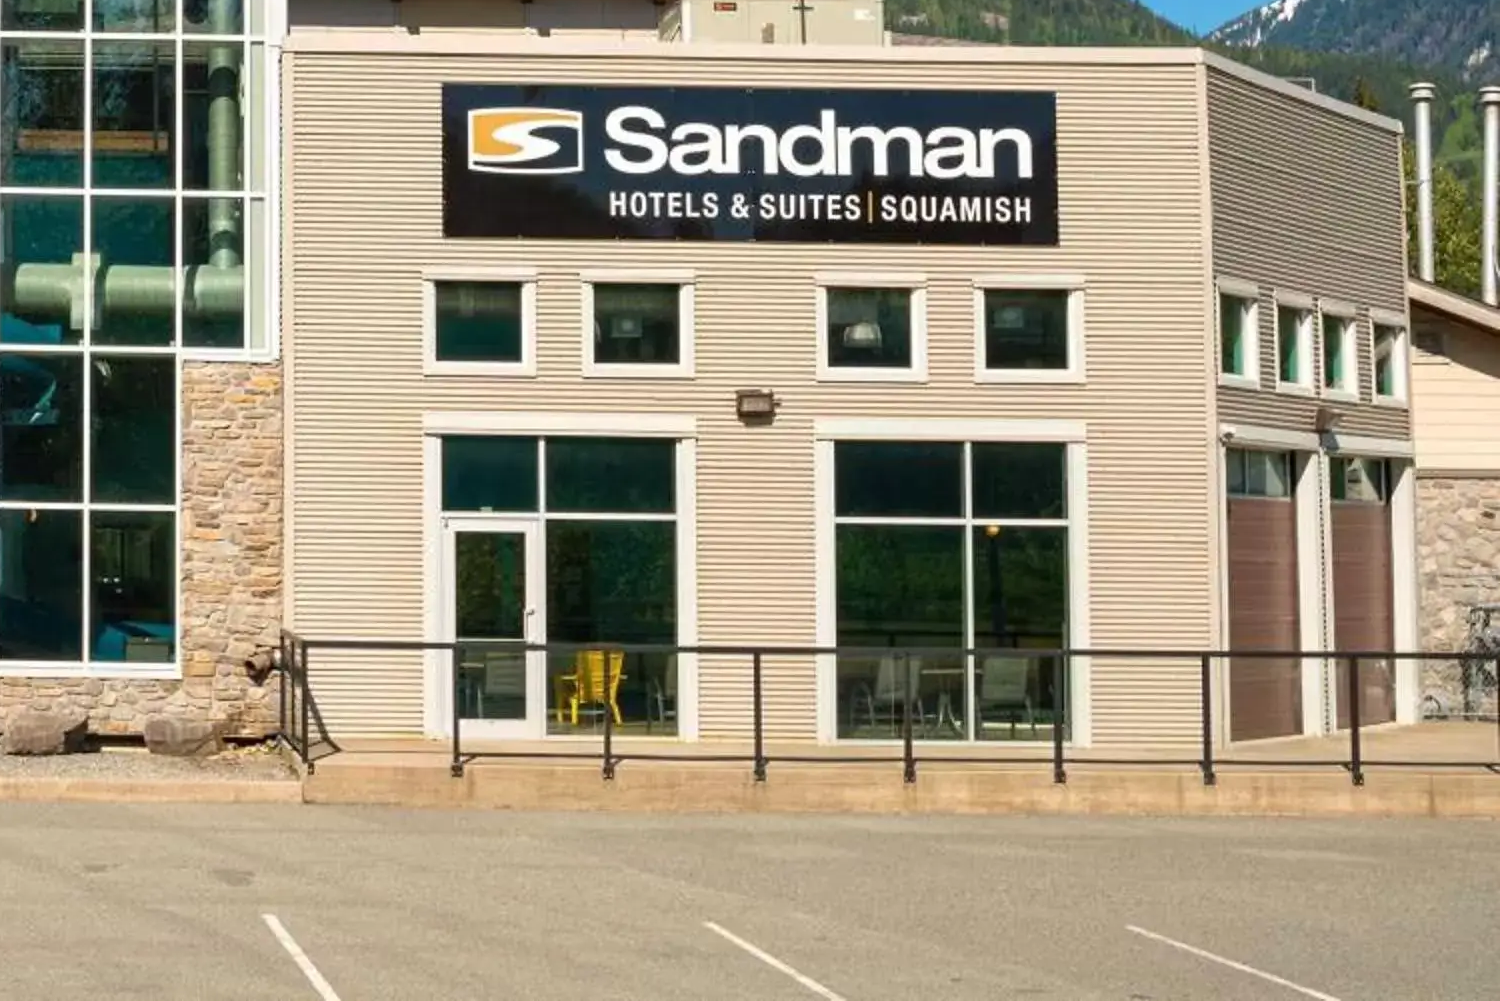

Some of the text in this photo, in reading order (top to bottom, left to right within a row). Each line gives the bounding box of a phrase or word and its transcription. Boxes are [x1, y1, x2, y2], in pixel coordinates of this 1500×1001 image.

[603, 105, 1034, 180] Sandman
[608, 190, 1032, 224] HOTELS & SUITES SQUAMISH
